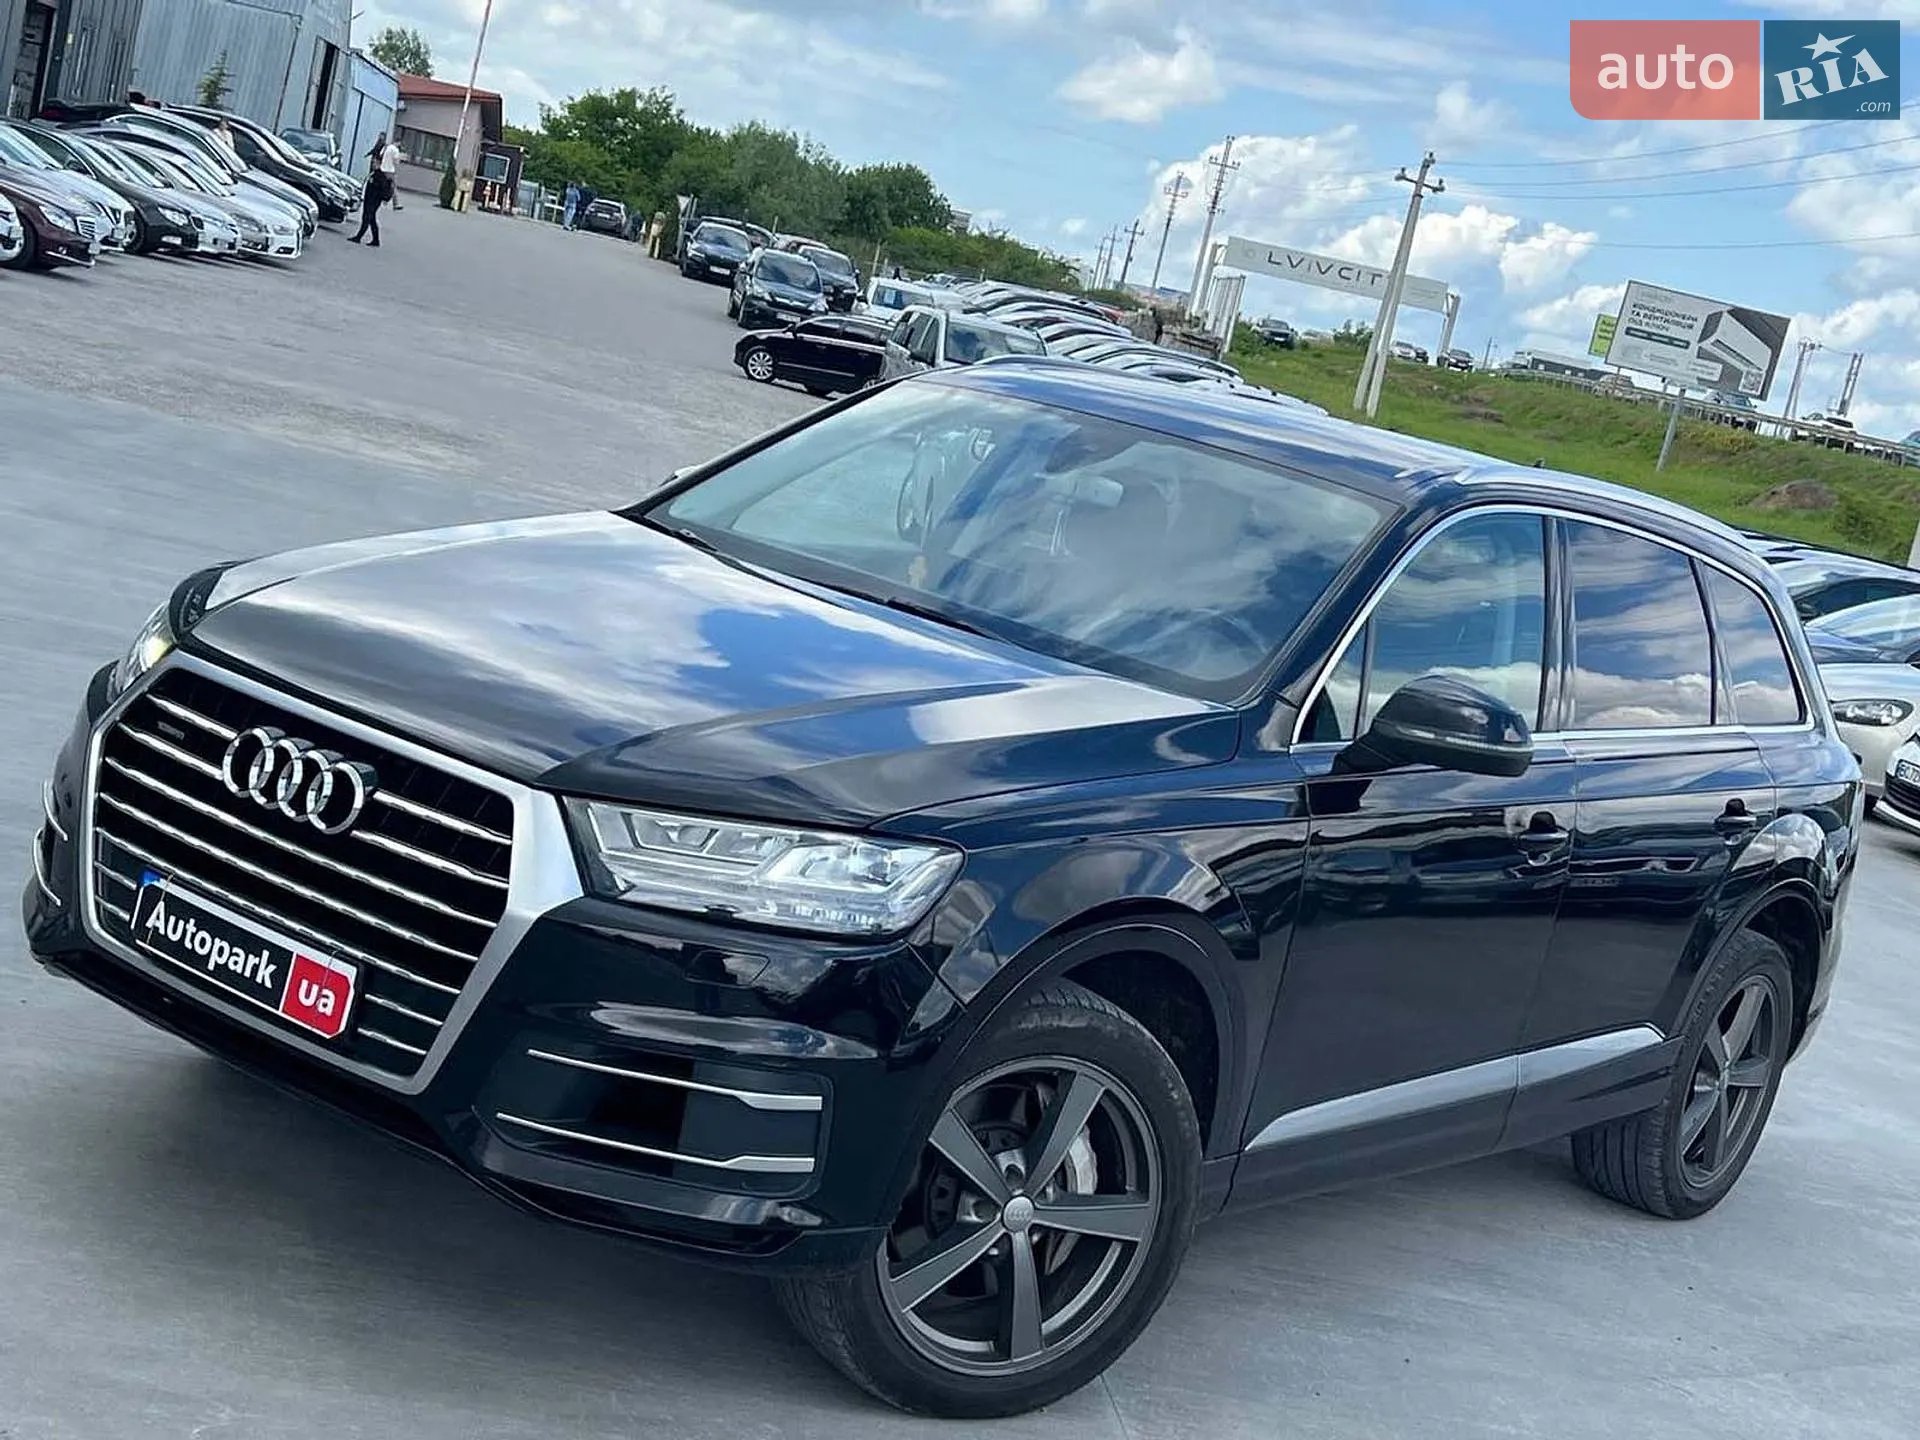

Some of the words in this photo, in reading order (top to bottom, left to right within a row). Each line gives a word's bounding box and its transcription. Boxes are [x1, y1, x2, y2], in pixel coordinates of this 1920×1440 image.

[1267, 250, 1389, 286] LVIVCIT
[145, 900, 277, 989] Autopark
[298, 978, 336, 1017] ua
